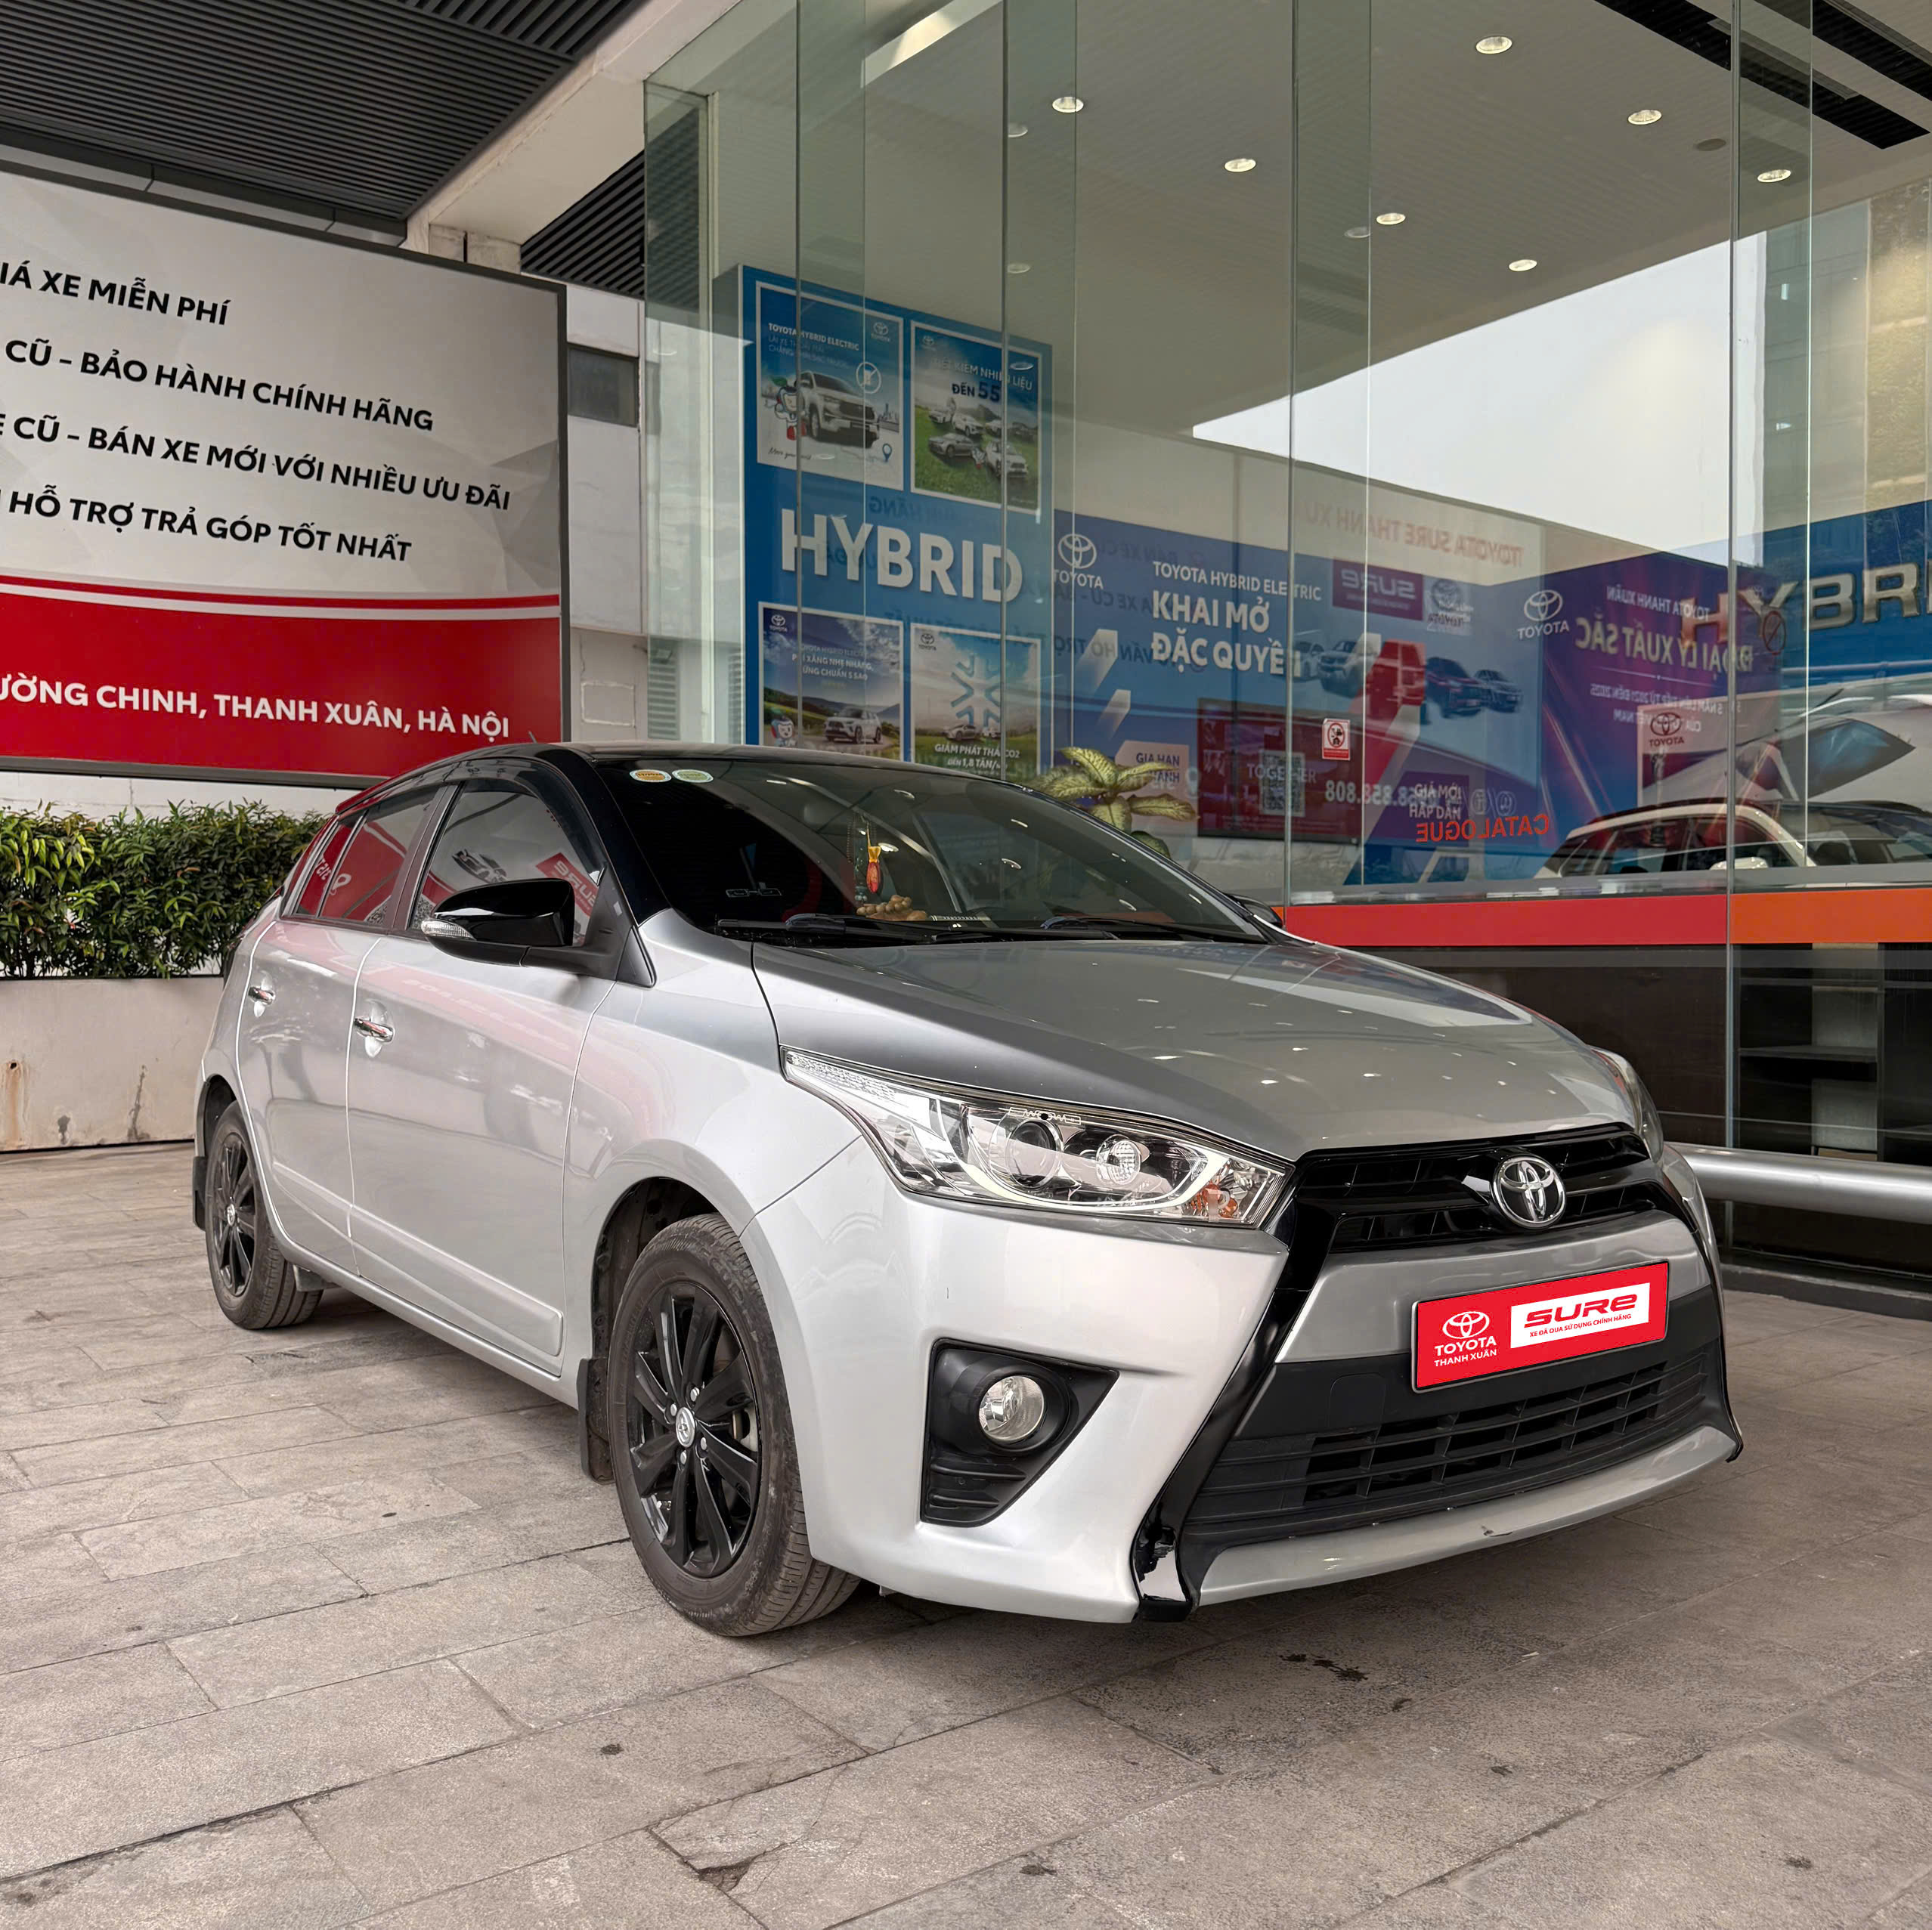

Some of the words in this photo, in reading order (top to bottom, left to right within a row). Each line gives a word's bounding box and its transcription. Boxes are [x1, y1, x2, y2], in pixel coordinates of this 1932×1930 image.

[39, 269, 81, 298] XE
[88, 277, 169, 316] MIỄN
[177, 297, 231, 326] PHÍ
[768, 323, 797, 336] TOYOTA
[827, 337, 859, 351] ELECTRIC
[5, 338, 52, 366] CŨ
[80, 348, 148, 383] BẢO
[154, 360, 246, 400] HÀNH
[252, 383, 347, 417] CHÍNH
[353, 397, 434, 431] HÃNG
[952, 382, 975, 397] ĐẾN
[14, 414, 60, 442] CŨ
[88, 426, 155, 457] BÁN
[160, 438, 199, 465] XE
[206, 444, 266, 475] MỚI
[274, 452, 324, 484] VỚI
[330, 459, 416, 496] NHIỀU
[422, 475, 460, 503] ƯU
[465, 484, 511, 512] ĐÃI
[9, 484, 60, 518] HỖ
[69, 497, 134, 534] TRỢ
[141, 500, 198, 537] TRẢ
[206, 511, 272, 545] GÓP
[277, 521, 331, 554] TỐT
[336, 533, 413, 563] NHẤT
[781, 508, 1023, 604] HYBRID
[1054, 569, 1104, 590] TOYOTA
[1153, 561, 1207, 585] TOYOTA
[1210, 570, 1260, 592] HYBRID
[1264, 578, 1322, 602] ELETRIC
[1153, 590, 1218, 627] KHAI
[1226, 595, 1270, 633] MỞ
[1517, 620, 1570, 640] TOYOTA
[1151, 627, 1207, 673] ĐẶC
[96, 685, 208, 719] CHINH,
[214, 693, 317, 722] THANH
[324, 700, 411, 733] XUÂN,
[417, 707, 456, 734] HÀ
[461, 710, 509, 744] NỘI
[1649, 737, 1684, 747] TOYOTA
[1524, 1293, 1637, 1328] SURE
[1539, 1328, 1548, 1336] ĐÃ
[1549, 1326, 1563, 1335] QUA
[1564, 1324, 1572, 1333] SỬ
[1573, 1321, 1592, 1332] DỤNG
[1593, 1316, 1613, 1326] CHÍNH
[1614, 1313, 1632, 1322] HÃNG
[1435, 1335, 1497, 1356] TOYOTA
[1435, 1354, 1468, 1367] THANH
[1469, 1349, 1497, 1361] XUÂN
